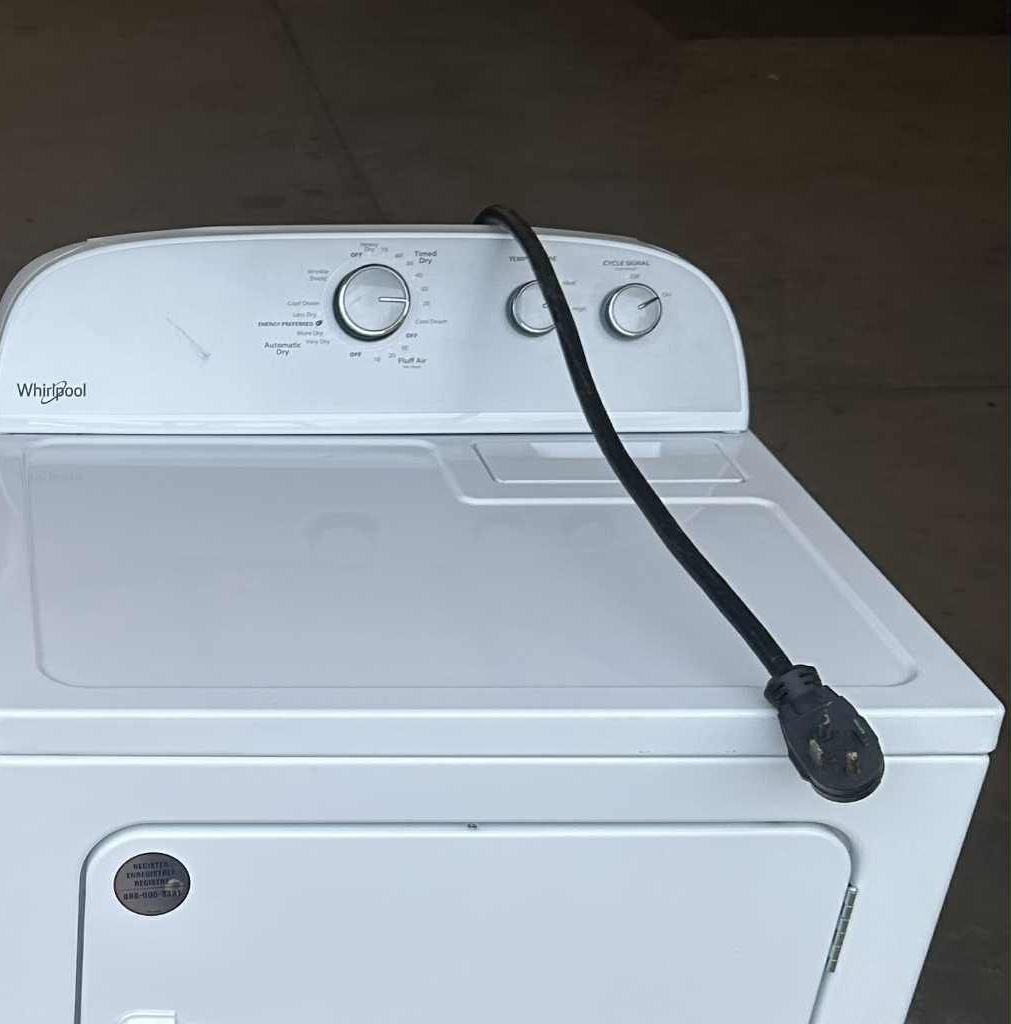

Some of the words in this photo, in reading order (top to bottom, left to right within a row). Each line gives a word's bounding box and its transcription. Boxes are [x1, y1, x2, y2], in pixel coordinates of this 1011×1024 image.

[419, 257, 433, 265] Dry
[264, 341, 302, 349] Automatic
[276, 348, 290, 357] Dry
[397, 356, 415, 364] Fluff
[17, 381, 86, 404] Whirlpool
[133, 861, 170, 870] REGISTER
